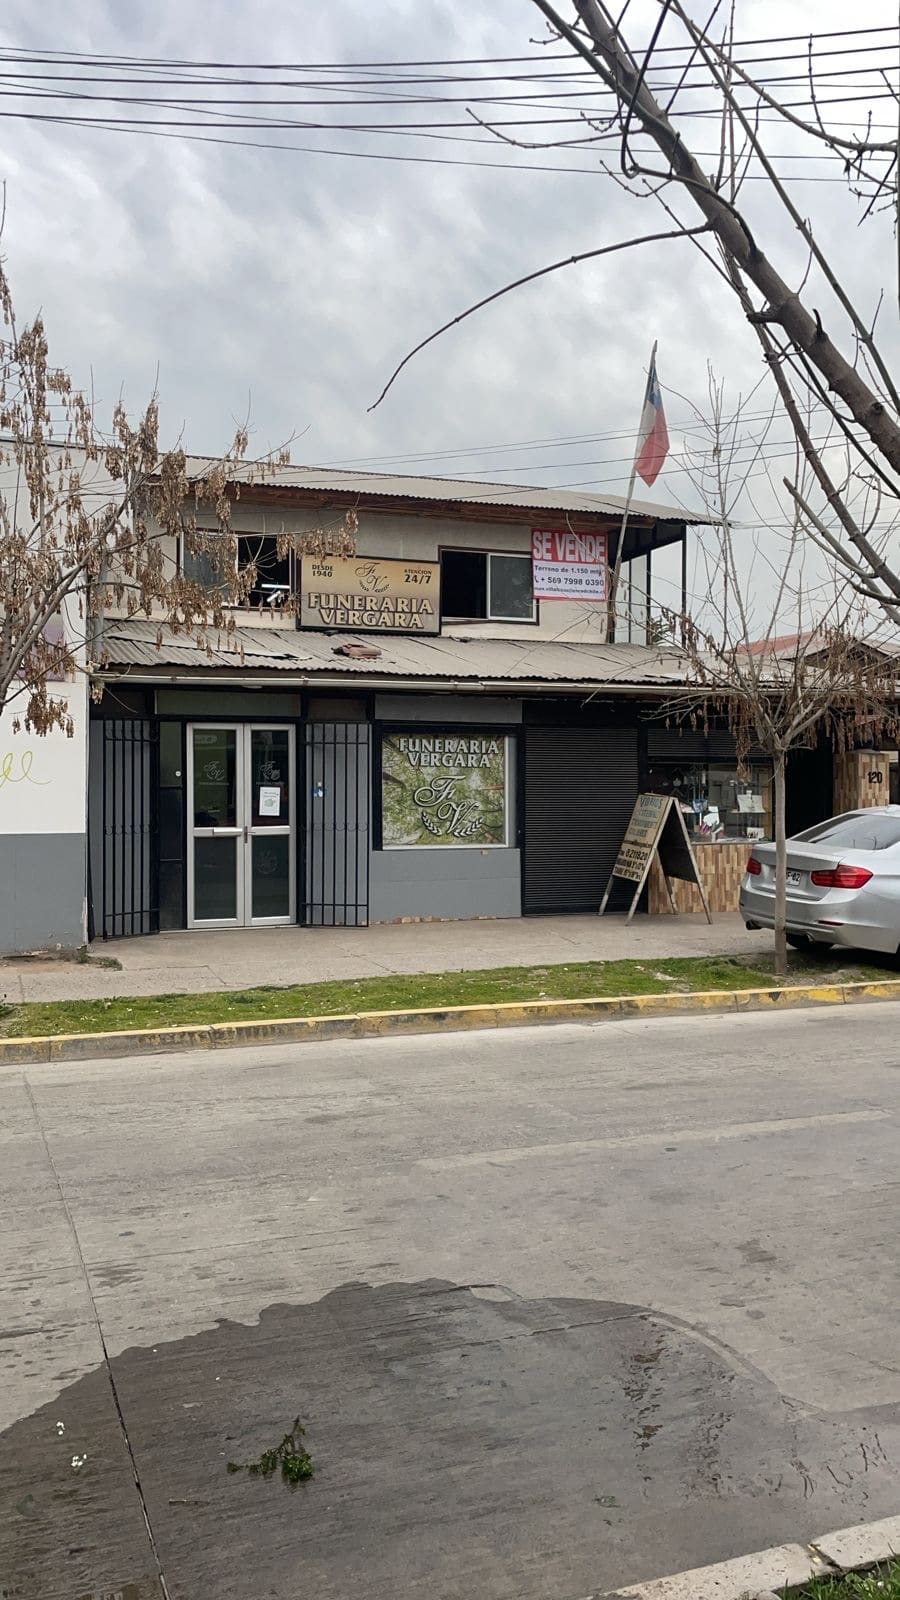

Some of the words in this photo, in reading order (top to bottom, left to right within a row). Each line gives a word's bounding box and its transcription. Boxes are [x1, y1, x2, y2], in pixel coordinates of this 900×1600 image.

[533, 531, 552, 560] SE
[555, 533, 606, 563] VENDE
[534, 565, 559, 573] Terreno
[404, 574, 432, 584] 24/7
[308, 592, 434, 614] FUNERARIA
[319, 609, 424, 628] VERGARA
[399, 738, 499, 754] FUNERARIA
[407, 752, 491, 768] VERGARA
[867, 771, 883, 784] 120
